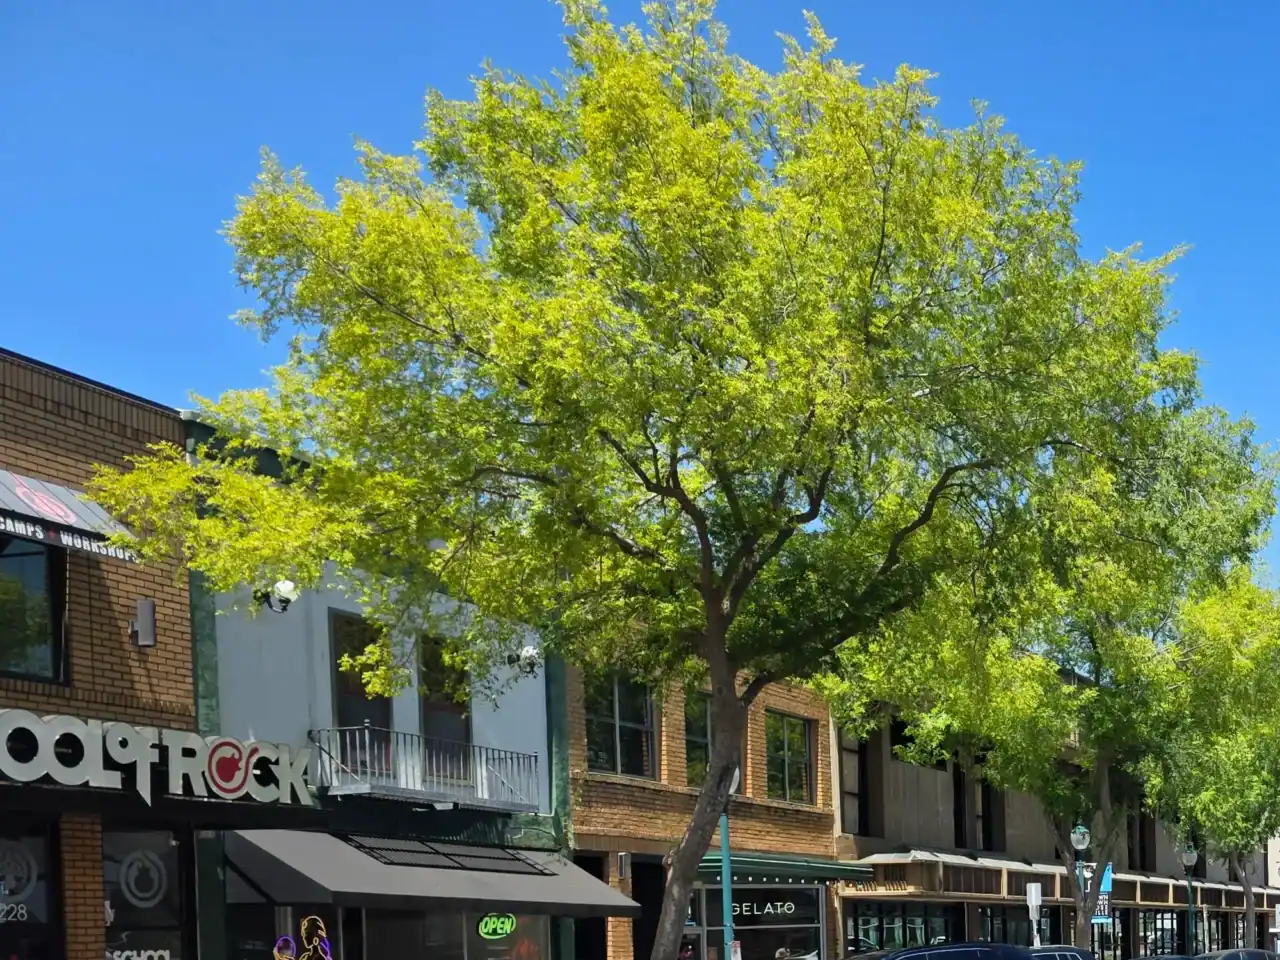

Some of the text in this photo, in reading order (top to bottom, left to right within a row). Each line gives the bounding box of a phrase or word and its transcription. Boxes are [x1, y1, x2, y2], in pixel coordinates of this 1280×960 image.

[162, 728, 313, 805] ROCK
[731, 902, 796, 915] GELATO
[482, 916, 513, 934] OPEN
